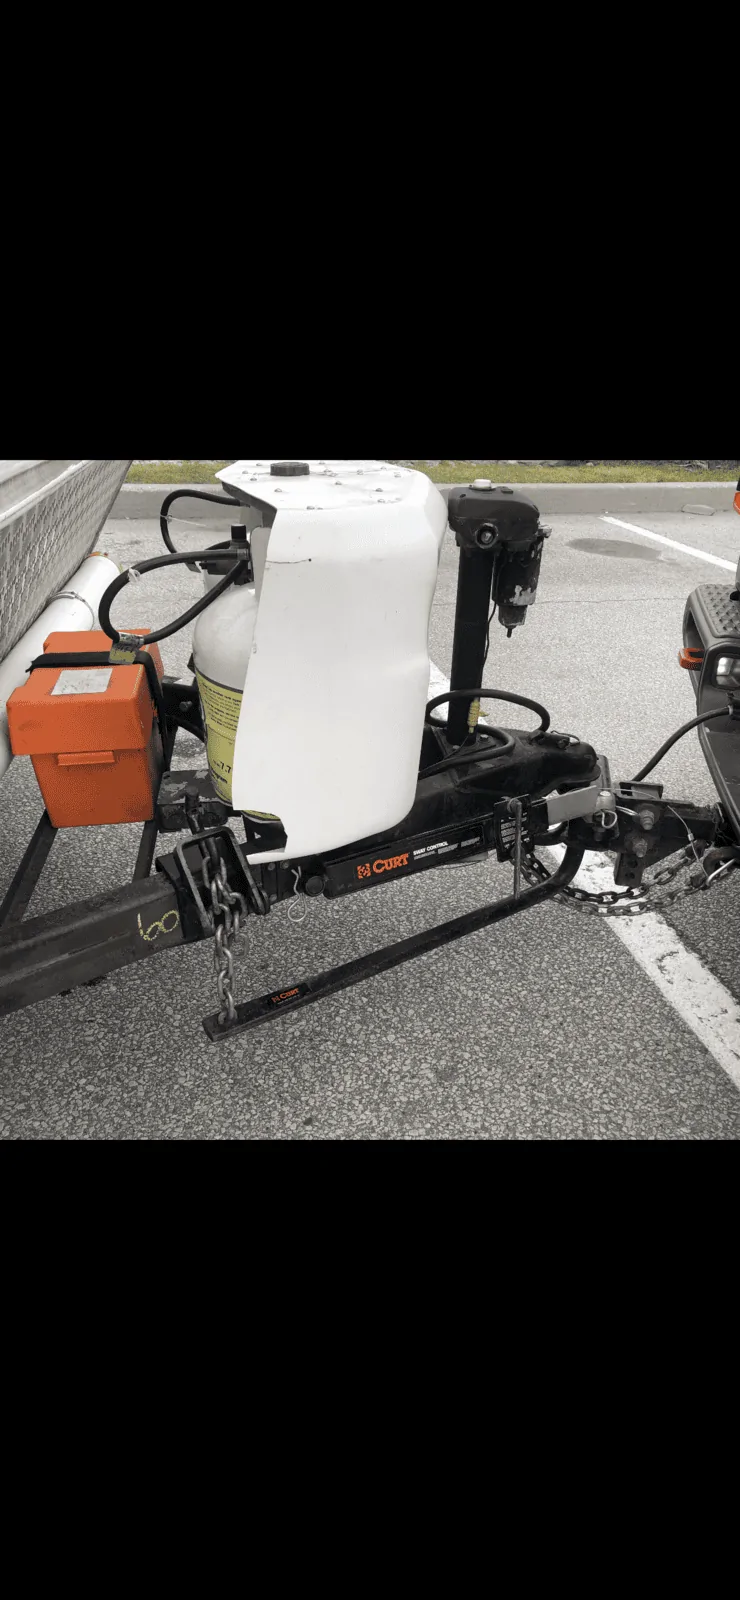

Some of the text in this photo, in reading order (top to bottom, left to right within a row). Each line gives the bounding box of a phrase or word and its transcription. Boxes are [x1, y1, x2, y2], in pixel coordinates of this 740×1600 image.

[413, 847, 426, 856] SWAY
[426, 841, 449, 851] CONTROL
[373, 852, 409, 873] CURT
[280, 987, 299, 999] CURT
